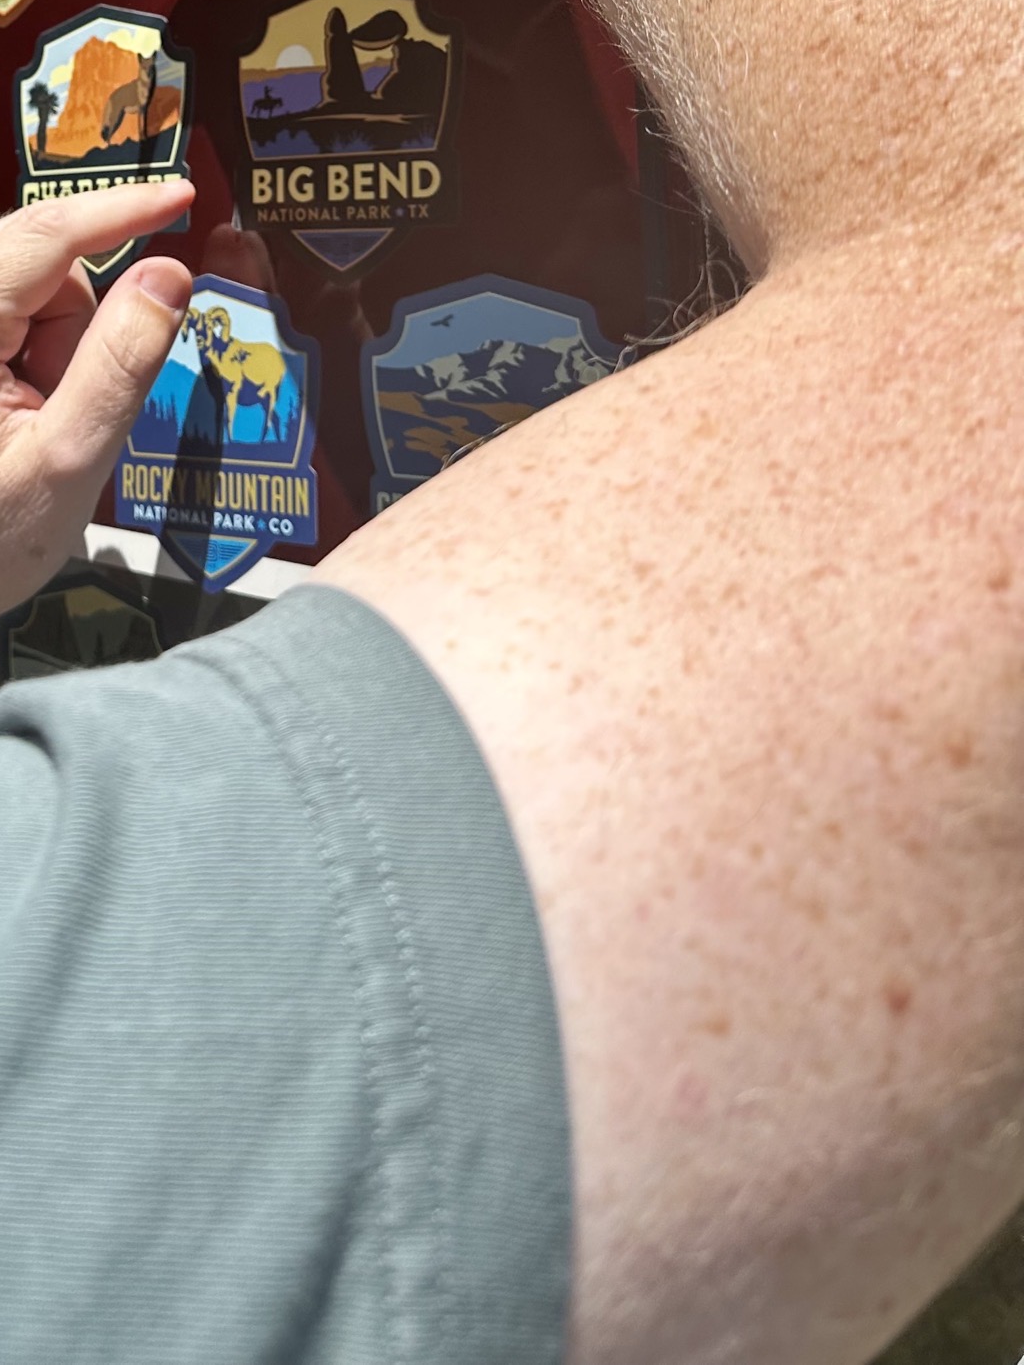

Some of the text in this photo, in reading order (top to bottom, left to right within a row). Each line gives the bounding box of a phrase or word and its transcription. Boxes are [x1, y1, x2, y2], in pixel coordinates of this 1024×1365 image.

[252, 160, 441, 204] BIG BEND
[257, 204, 429, 222] NATIONAL PARK TX
[122, 463, 309, 517] ROCKY MOUNTAIN
[133, 503, 294, 536] NATIONAL PARK CO
